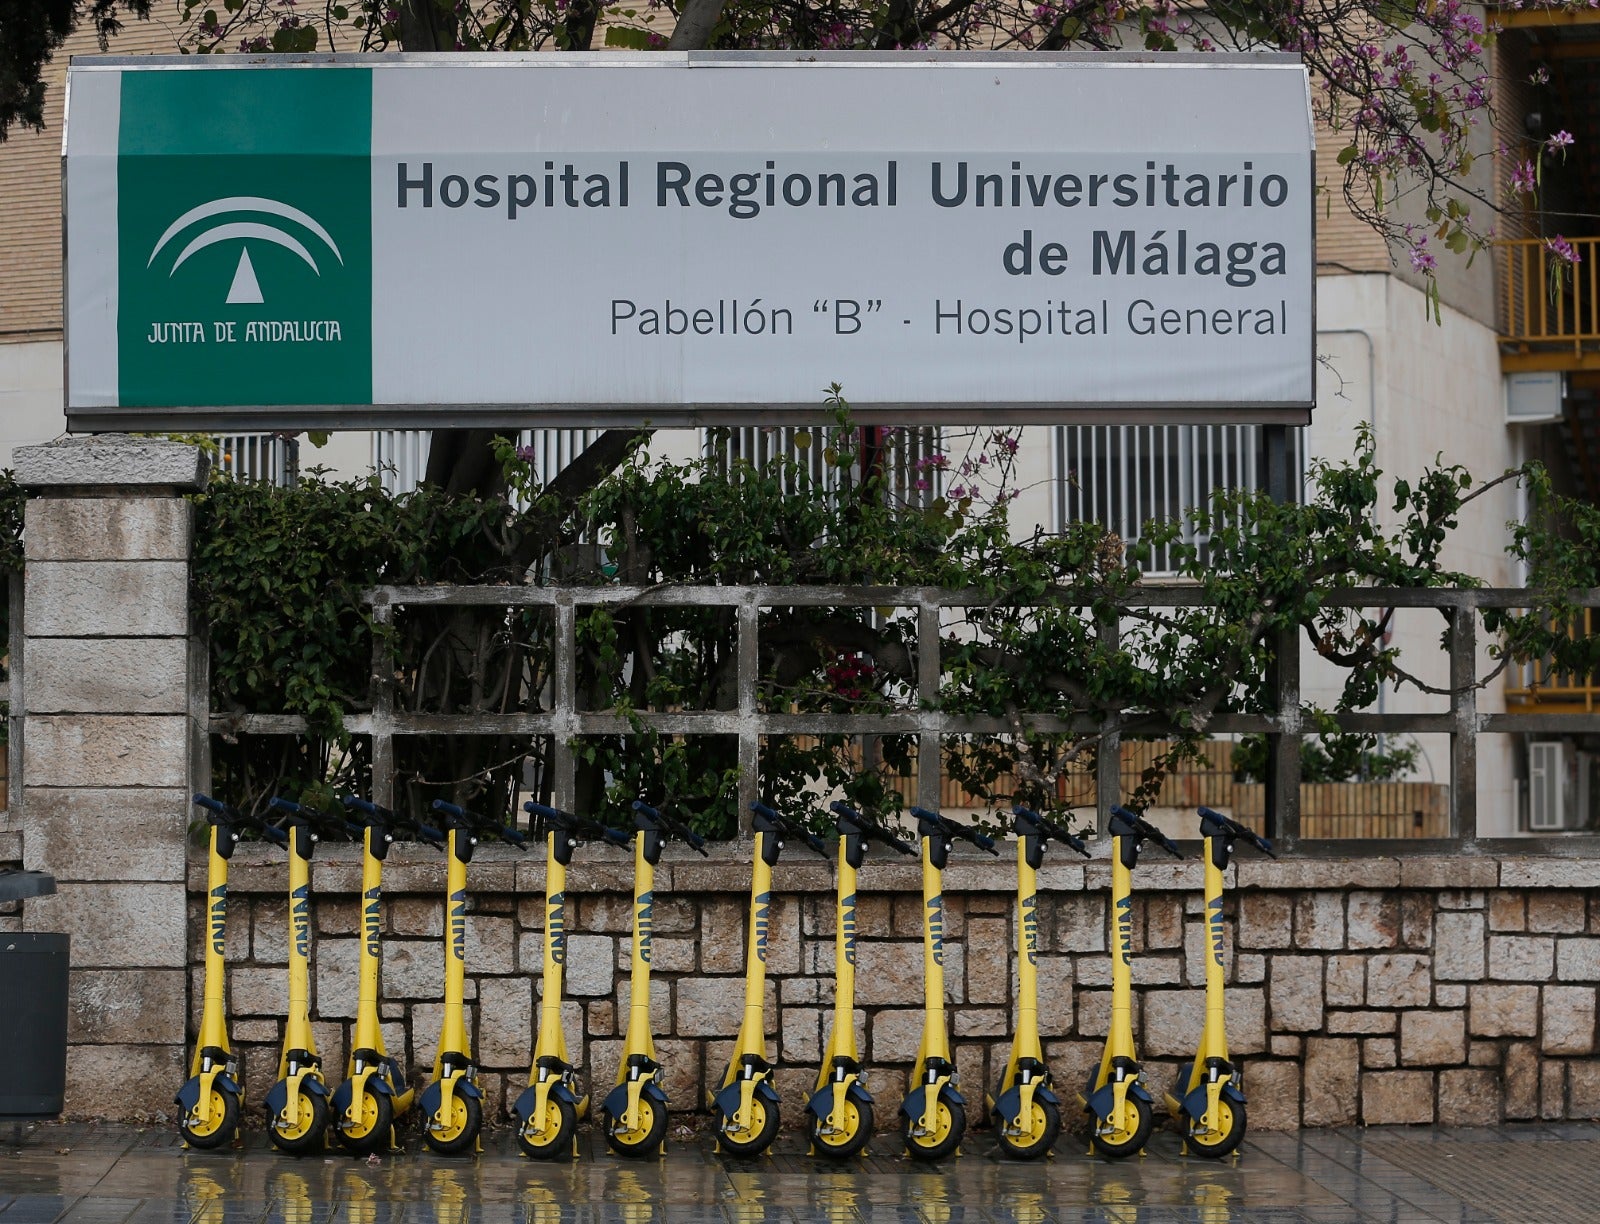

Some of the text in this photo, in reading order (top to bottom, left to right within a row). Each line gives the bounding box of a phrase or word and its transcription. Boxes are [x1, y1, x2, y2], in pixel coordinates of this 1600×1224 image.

[398, 160, 1288, 220] Hospital Regional Universitario
[1003, 229, 1287, 288] de Málaga
[147, 322, 205, 344] JUNTA
[214, 321, 237, 342] DE
[612, 298, 792, 336] Pabellón
[936, 299, 1108, 344] Hospital
[1128, 298, 1286, 336] General
[211, 884, 226, 955] WIND
[291, 884, 308, 957] WIND
[365, 885, 381, 958] WIND
[450, 888, 466, 961] WIND
[549, 890, 565, 965] WIND
[637, 890, 653, 963] WIND
[755, 890, 770, 962] WIND
[842, 893, 857, 966] WIND
[927, 893, 943, 967] WIND
[1022, 894, 1037, 966] WIND
[1116, 894, 1131, 967] WIND
[1208, 895, 1223, 967] WIND
